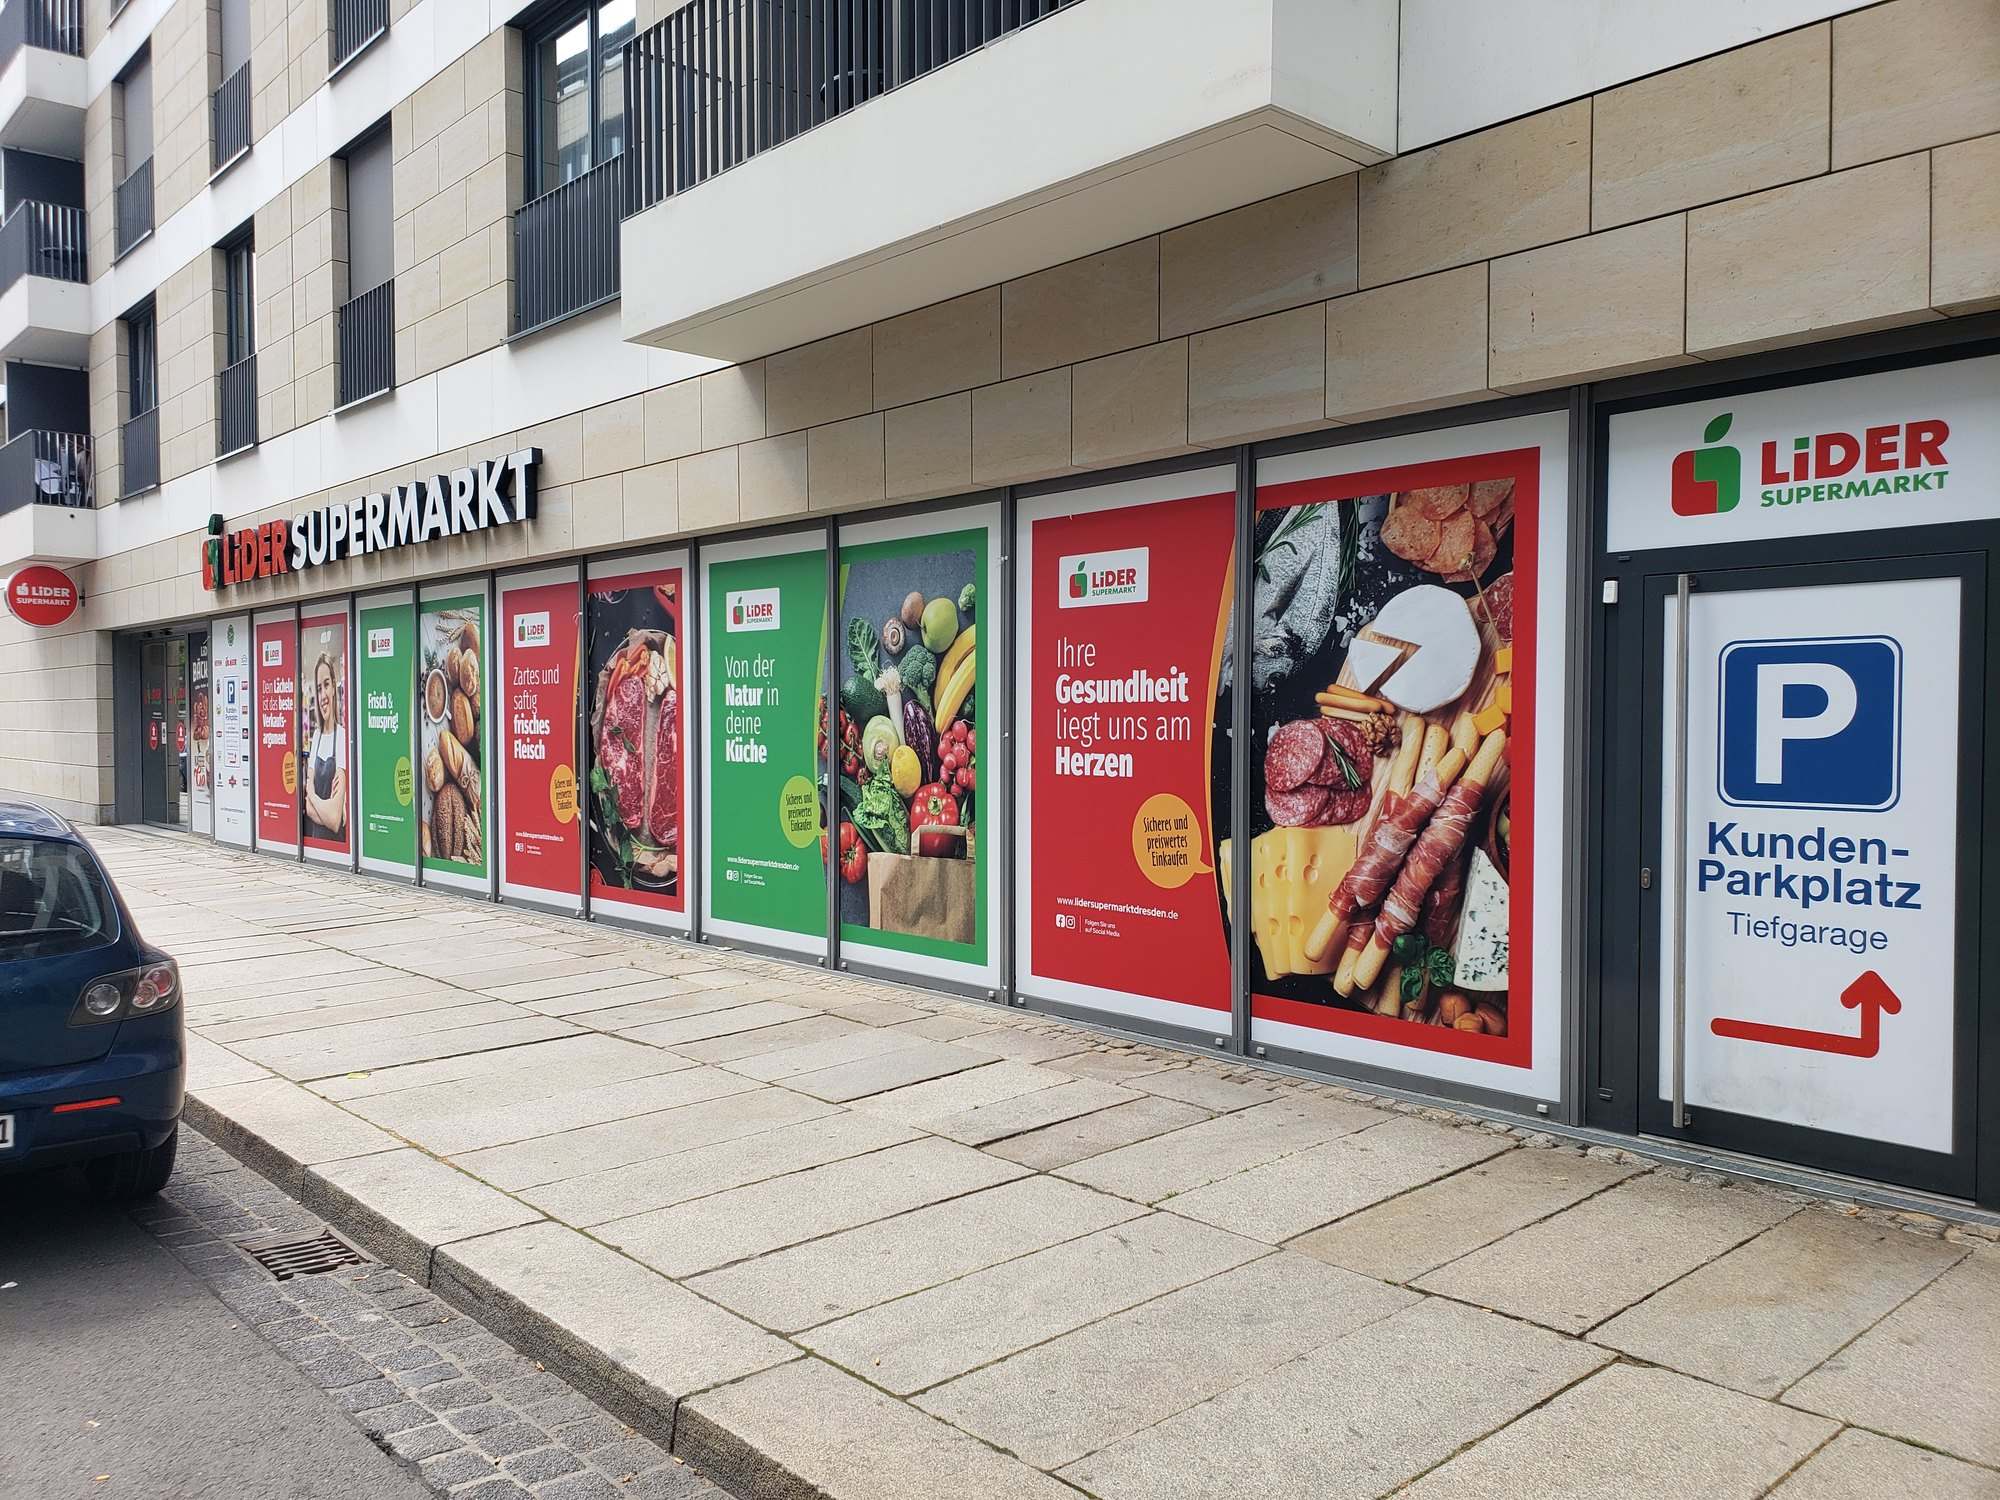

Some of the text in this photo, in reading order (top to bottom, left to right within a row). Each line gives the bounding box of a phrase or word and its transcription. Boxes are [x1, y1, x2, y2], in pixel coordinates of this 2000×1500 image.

[1760, 470, 1949, 508] SUPERMARKT
[291, 447, 543, 571] SUPERMARKT
[16, 597, 71, 606] SUPERMARKT
[1091, 586, 1137, 597] SUPERMARKT
[1056, 636, 1096, 668] Ihre
[513, 664, 560, 686] Zartes und
[725, 653, 775, 679] Von der
[725, 681, 779, 707] Natur in
[1055, 666, 1189, 705] Gesundheit
[279, 697, 294, 711] beste
[368, 690, 394, 709] Frisch &
[513, 689, 538, 715] saftig
[368, 710, 399, 734] knusprig!
[513, 713, 550, 736] frisches
[726, 710, 761, 735] deine
[1056, 708, 1191, 748] liegt uns am
[1755, 662, 1858, 785] P
[513, 737, 545, 760] Fleisch
[725, 737, 768, 764] Küche
[1055, 746, 1133, 778] Herzen
[1143, 814, 1189, 833] Sicheres und
[1146, 834, 1188, 852] preiswertes
[1707, 821, 1910, 866] Kunden-
[1151, 851, 1188, 868] Einkaufen
[1698, 858, 1922, 910] Parkplatz
[1056, 896, 1179, 920] www.lidersupermarktdresden.de
[1726, 911, 1889, 955] Tiefgarage
